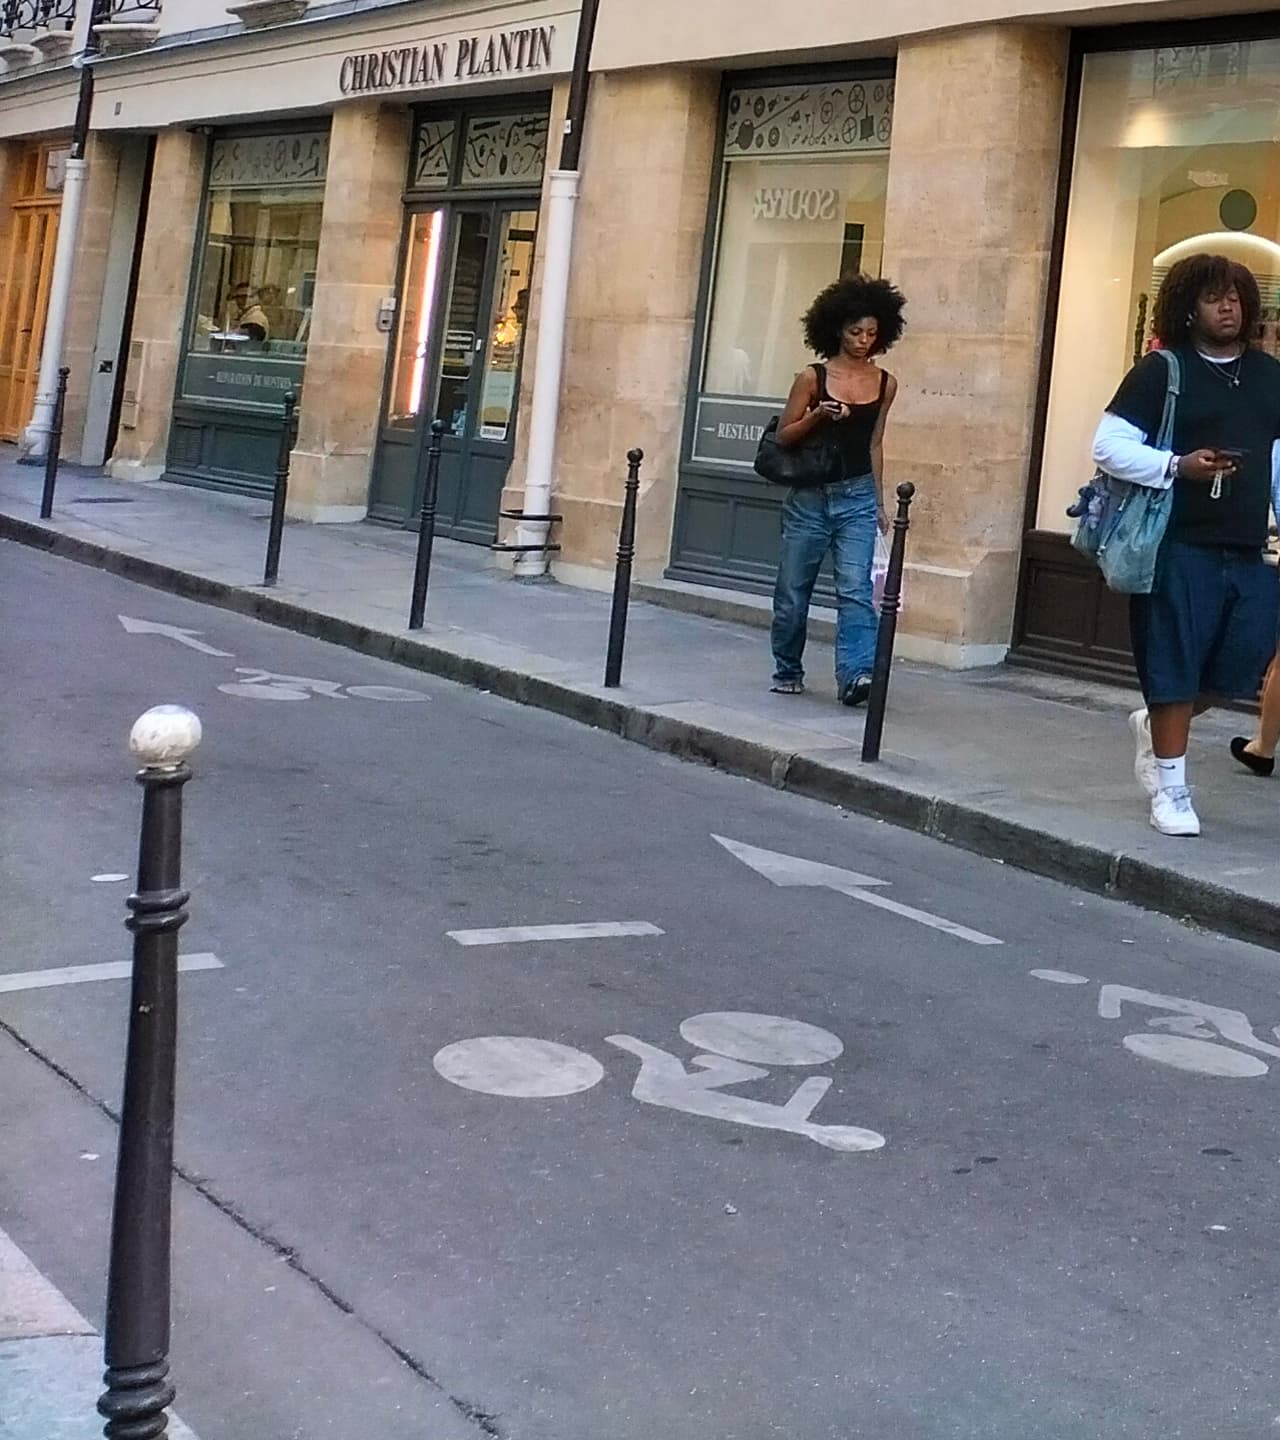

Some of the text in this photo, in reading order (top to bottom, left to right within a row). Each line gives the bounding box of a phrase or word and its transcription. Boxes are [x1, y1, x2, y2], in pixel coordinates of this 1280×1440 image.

[339, 25, 556, 94] CHRISTIAN PLANTIN
[717, 422, 766, 441] RESTAUR
